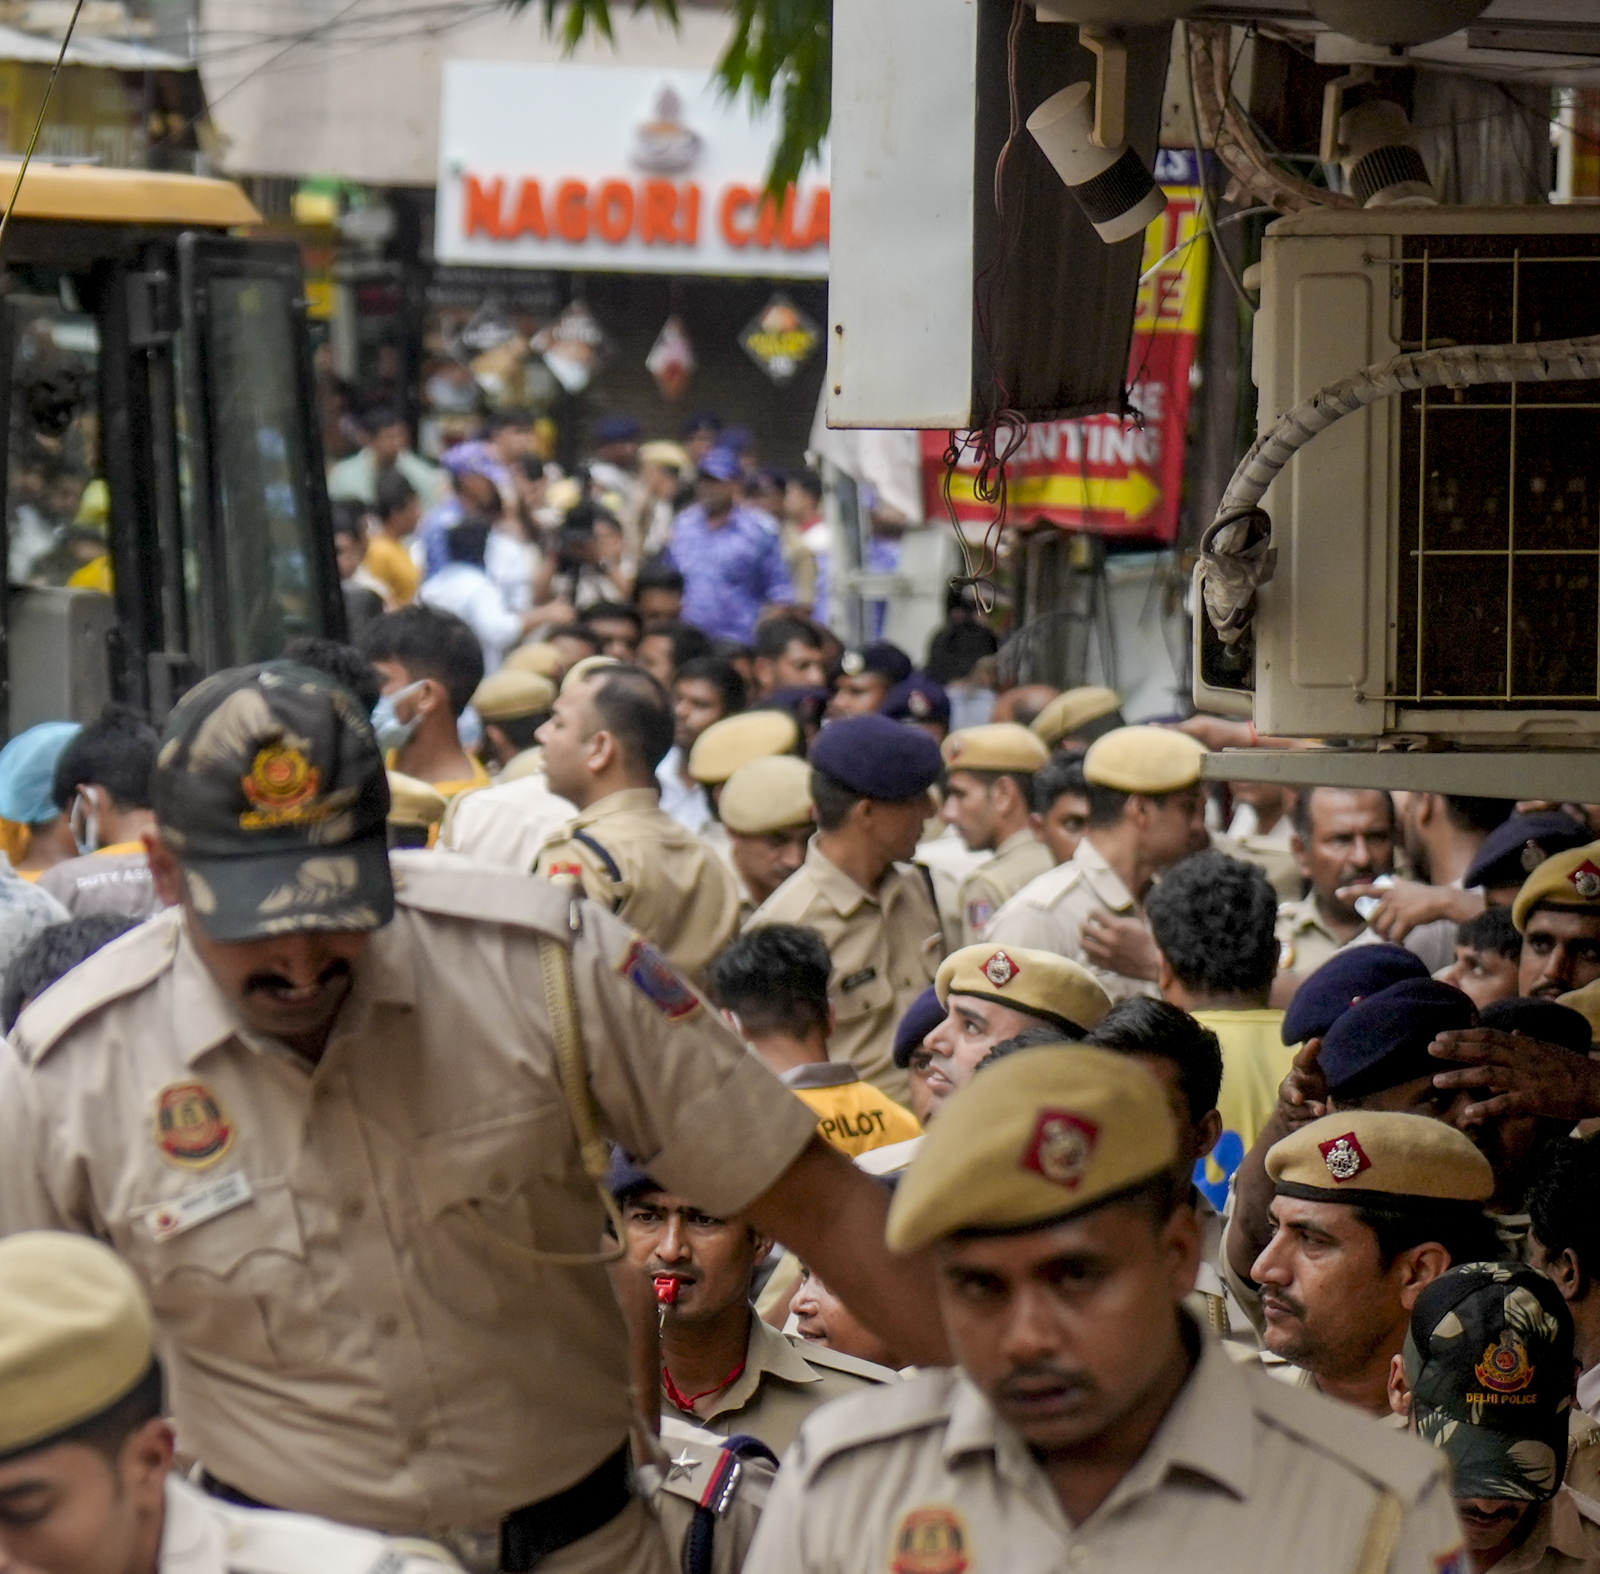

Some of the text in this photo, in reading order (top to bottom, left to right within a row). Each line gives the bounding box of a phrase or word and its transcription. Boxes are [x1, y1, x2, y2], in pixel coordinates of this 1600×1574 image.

[464, 173, 701, 245] NAGORI
[76, 872, 120, 889] DUTY
[821, 1109, 885, 1141] PILOT
[1466, 1393, 1538, 1405] DELHI POLICE
